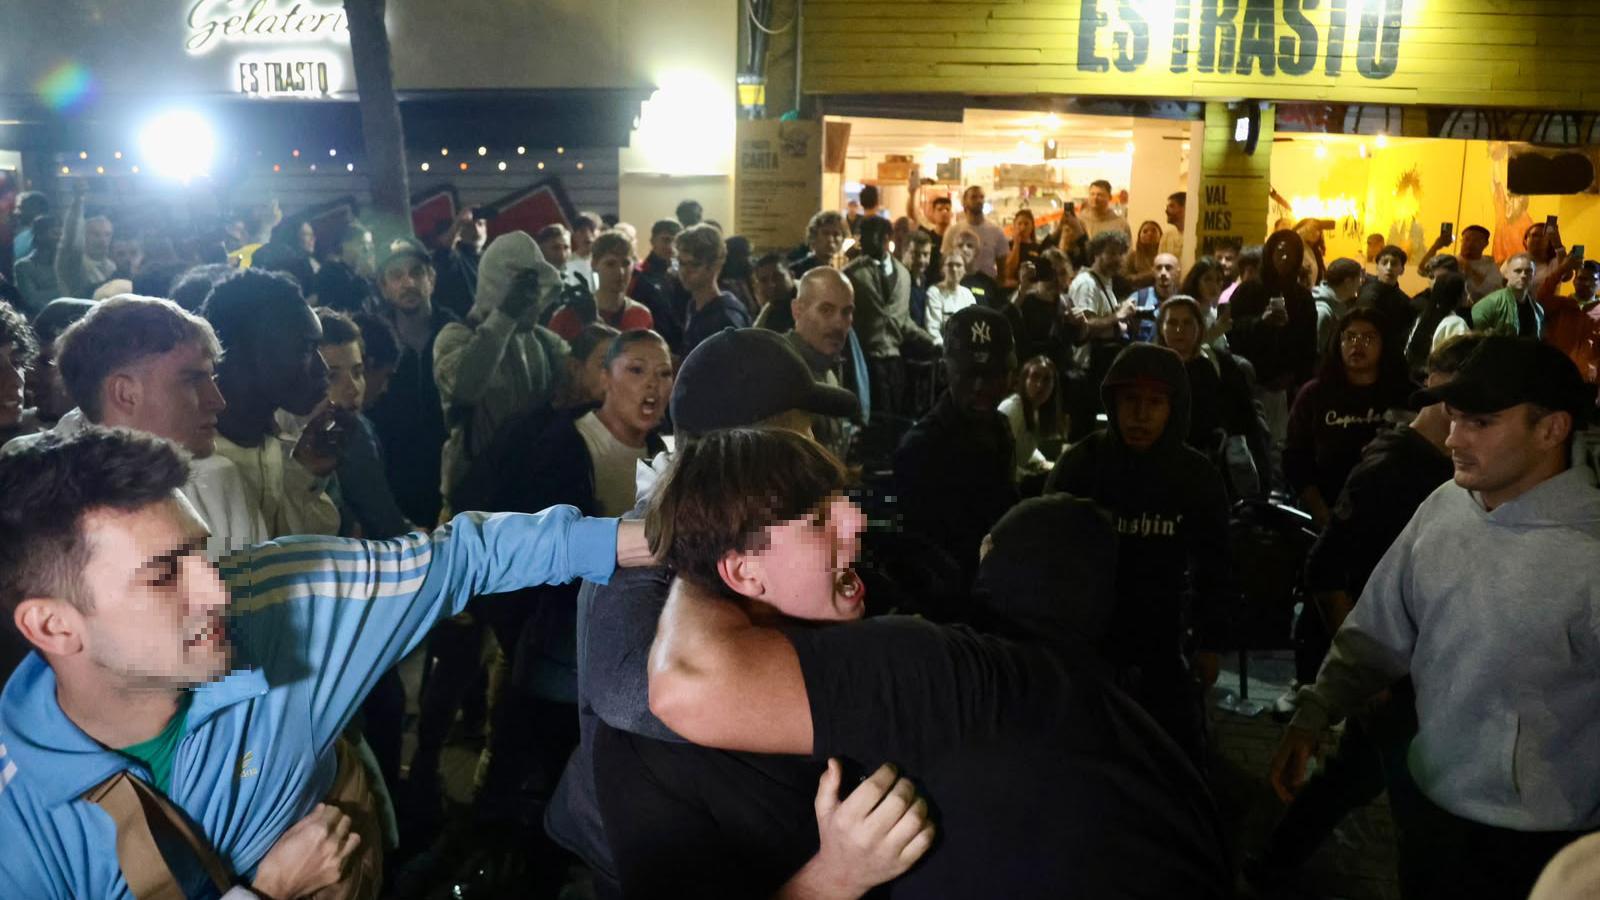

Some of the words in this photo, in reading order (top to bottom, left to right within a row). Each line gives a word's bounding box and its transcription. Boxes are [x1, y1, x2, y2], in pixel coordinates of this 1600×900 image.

[187, 0, 348, 49] Gelateri
[1077, 0, 1150, 73] ES
[240, 62, 259, 93] ES
[264, 61, 328, 93] TRASTO
[1206, 186, 1229, 205] VAL
[971, 321, 991, 343] NY
